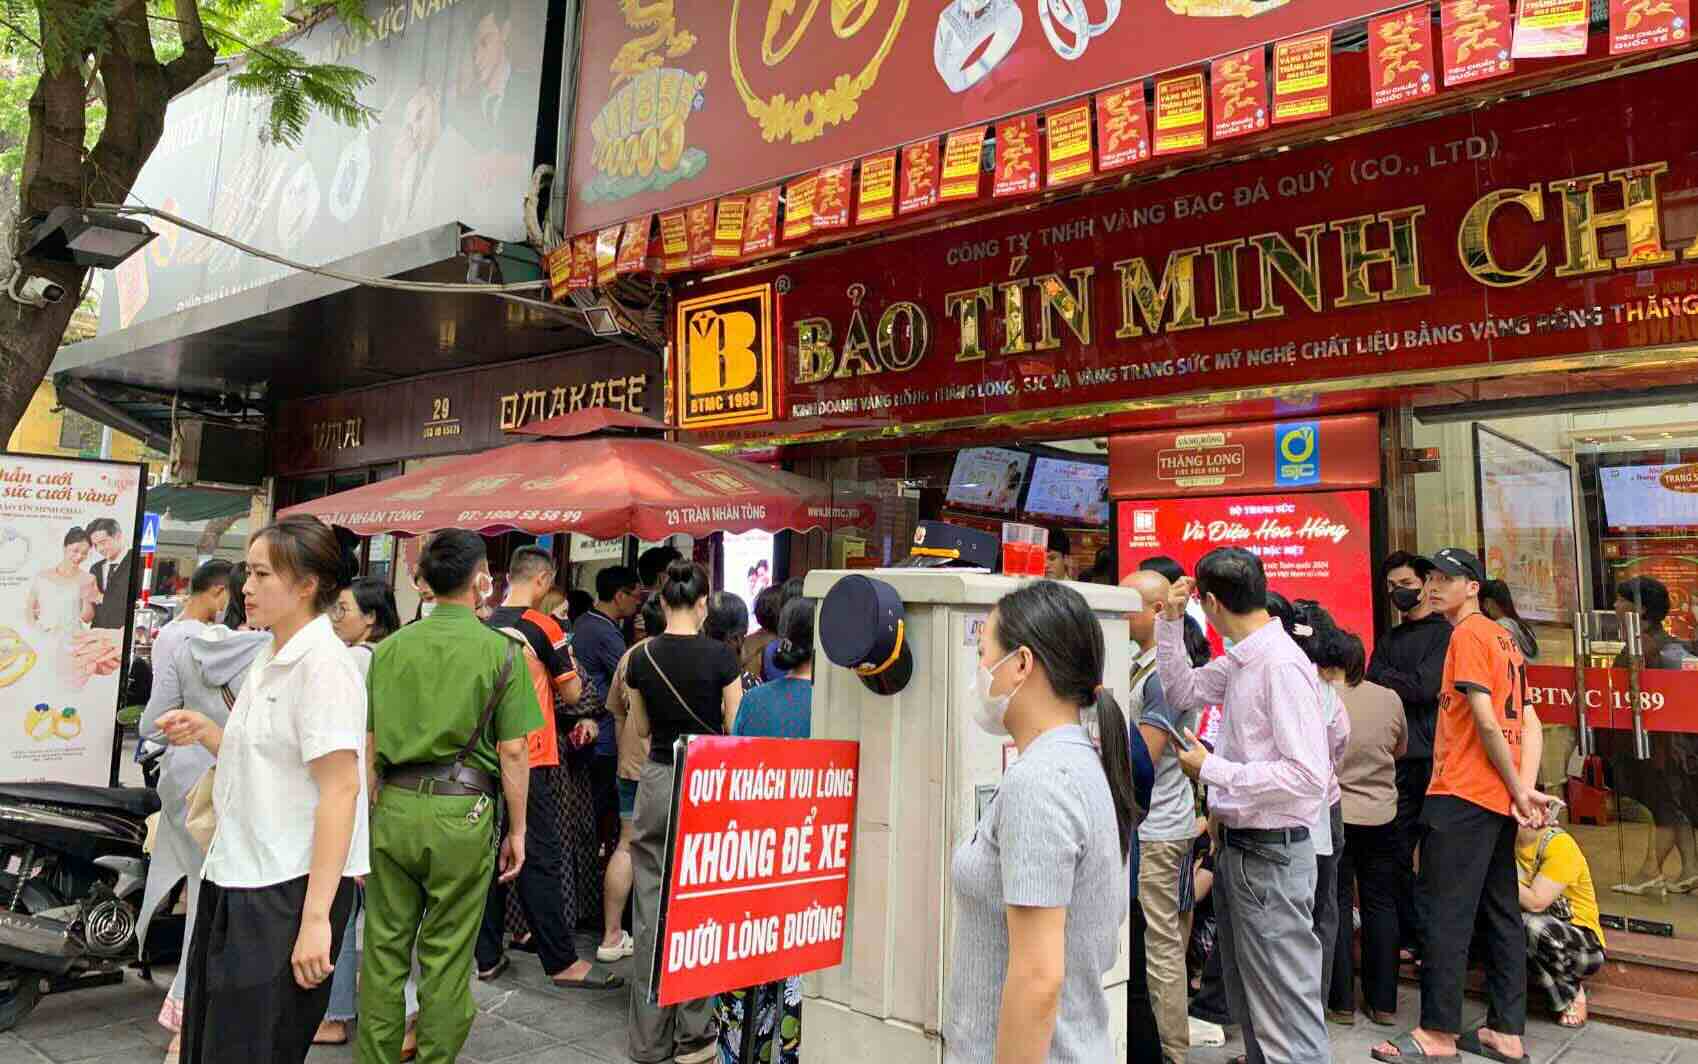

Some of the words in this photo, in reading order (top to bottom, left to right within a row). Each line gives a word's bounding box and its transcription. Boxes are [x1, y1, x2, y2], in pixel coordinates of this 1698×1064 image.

[1615, 39, 1648, 48] QUỐC
[1447, 71, 1479, 81] QUỐC
[946, 240, 999, 265] CÔNG
[1040, 219, 1094, 246] TNHH
[1103, 207, 1165, 233] VÀNG
[1174, 191, 1224, 222] BẠC
[1232, 176, 1271, 207] ĐÁ
[1277, 166, 1334, 198] QUÝ
[1350, 154, 1419, 185] (CO.,
[1428, 130, 1500, 167] LTD)
[793, 283, 928, 385] BẢO
[945, 256, 1096, 362] TÍN
[1113, 204, 1432, 340] MINH
[1458, 161, 1698, 287] CH
[861, 391, 892, 411] VÀNG
[1023, 375, 1047, 393] SJC
[1054, 369, 1072, 389] VÀ
[1120, 359, 1175, 381] TRANG
[1176, 352, 1212, 376] SỨC
[1215, 348, 1243, 371] MỸ
[1247, 343, 1296, 367] NGHỆ
[1301, 333, 1351, 359] CHẤT
[1356, 330, 1399, 356] LIỆU
[1404, 320, 1463, 348] BẰNG
[1469, 313, 1531, 343] VÀNG
[1610, 294, 1698, 324] THĂNG
[431, 398, 450, 421] 29
[690, 395, 724, 413] BTMC
[728, 390, 759, 409] 1989
[1160, 452, 1203, 469] THĂNG
[1206, 452, 1241, 466] LONG
[37, 471, 73, 486] cưới
[3, 484, 33, 499] sức
[36, 487, 73, 501] cưới
[77, 488, 119, 506] vàng
[518, 510, 537, 521] 58
[539, 510, 560, 522] 58
[561, 510, 582, 523] 99
[665, 509, 679, 525] 29
[712, 503, 740, 521] NHÂN
[741, 503, 767, 521] TÔNG
[1207, 520, 1250, 542] Điệu
[1254, 517, 1294, 540] Hoa
[1296, 515, 1350, 543] Hồng
[1530, 687, 1601, 708] BTMC
[689, 763, 726, 808] QUÝ
[729, 763, 785, 801] KHÁCH
[790, 771, 814, 798] VUI
[816, 762, 853, 798] LÒNG
[679, 820, 775, 886] KHÔNG
[781, 806, 818, 874] ĐỂ
[818, 822, 848, 870] XE
[668, 915, 723, 972] DƯỚI
[727, 912, 780, 961] LÒNG
[782, 900, 843, 949] ĐƯỜNG
